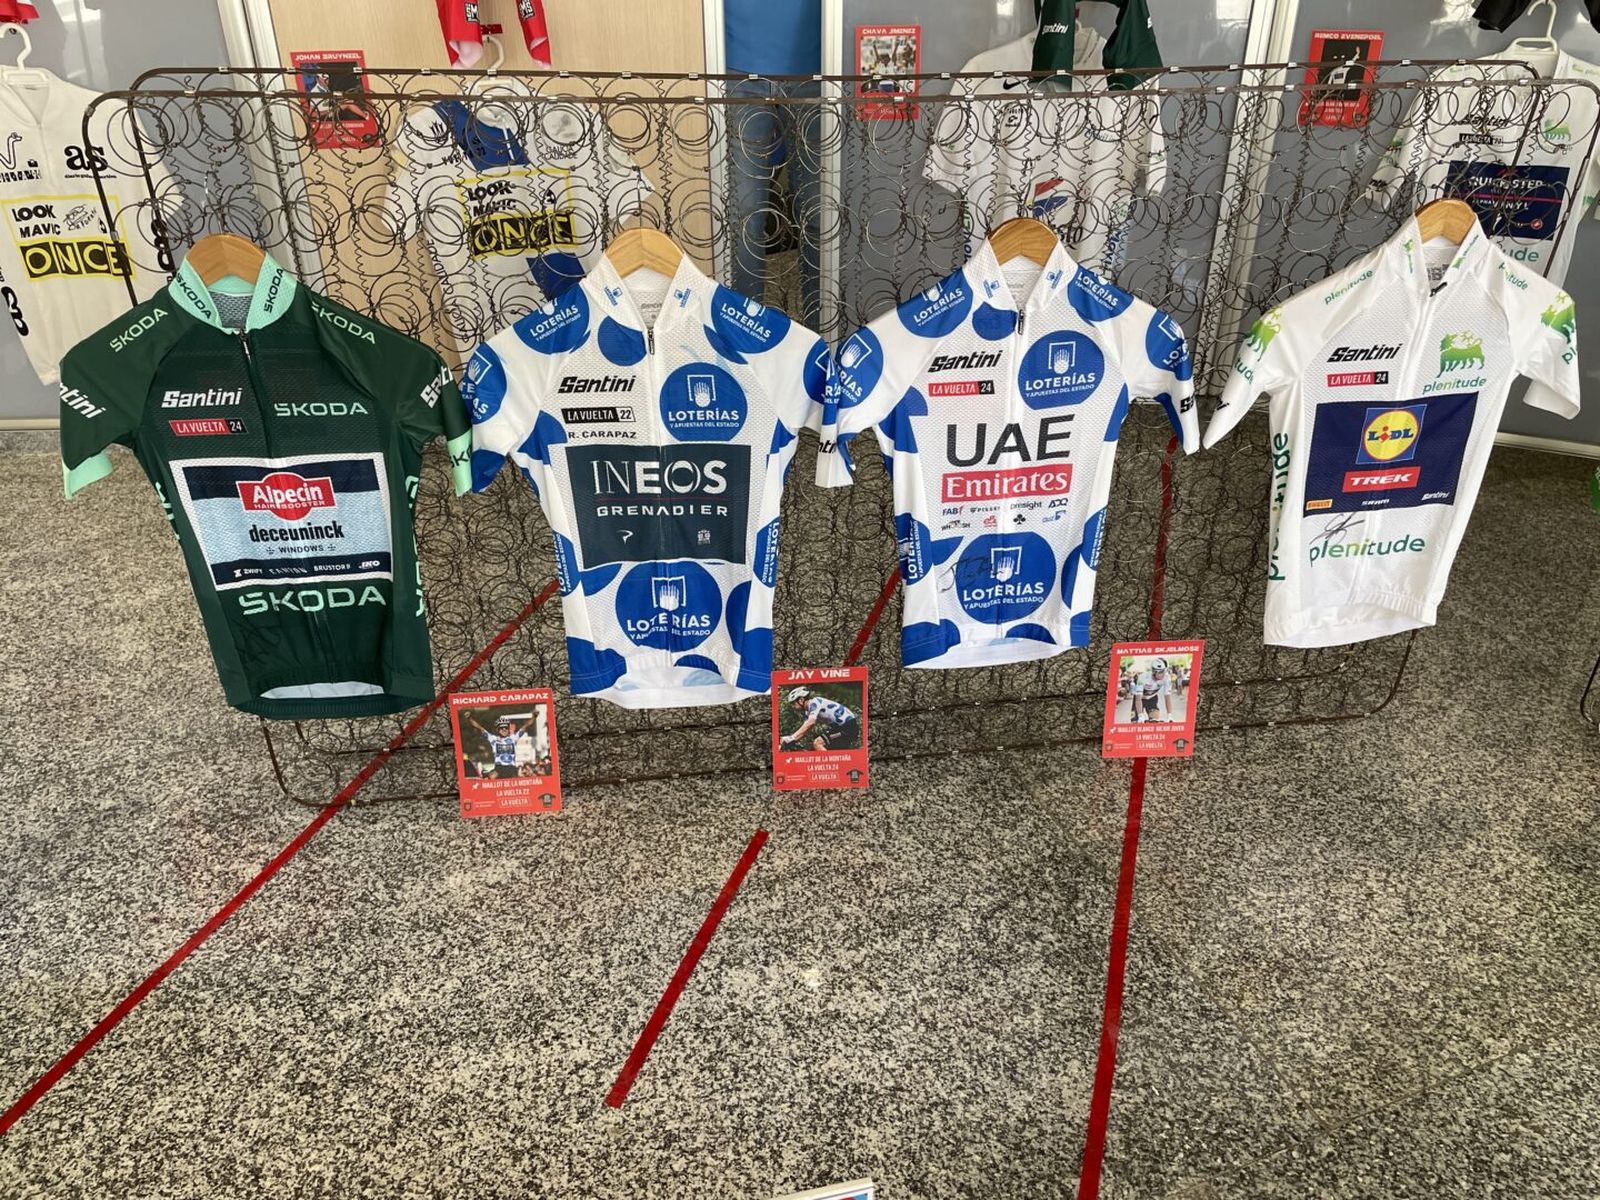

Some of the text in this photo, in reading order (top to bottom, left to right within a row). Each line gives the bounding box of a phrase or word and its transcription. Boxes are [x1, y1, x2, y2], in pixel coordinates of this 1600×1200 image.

[64, 145, 109, 172] as
[12, 204, 57, 222] LOOK
[19, 223, 62, 239] MAVIC
[22, 242, 130, 277] ONCE
[721, 302, 772, 339] LOTERÍAS
[927, 349, 1004, 373] Santini
[1327, 342, 1404, 363] Santini
[557, 375, 637, 394] Santini
[931, 382, 992, 394] LA VUELTA 24
[1025, 372, 1096, 391] LOTERÍAS
[1331, 373, 1387, 385] LA VUELTA 24
[1422, 376, 1488, 396] plenitude
[161, 387, 244, 408] Santini
[567, 409, 632, 421] LA VUELTA 22
[668, 408, 740, 423] LOTERÍAS
[175, 420, 242, 434] LA VUELTA 24
[582, 430, 637, 440] CARAPAZ
[946, 413, 1076, 468] UAE
[590, 459, 728, 496] INEOS
[947, 471, 1069, 500] Emirates
[1350, 473, 1414, 486] TREK
[252, 483, 324, 509] Alpecin
[596, 504, 729, 517] GRENADIER
[249, 520, 345, 543] deceuninck
[278, 544, 324, 554] WINDOWS
[1309, 534, 1426, 568] plenitude
[962, 581, 1045, 602] LOTERÍAS
[626, 612, 711, 632] LOTERÍAS
[788, 668, 851, 680] JAY VINE
[452, 692, 549, 705] RICHARD CARAPAZ
